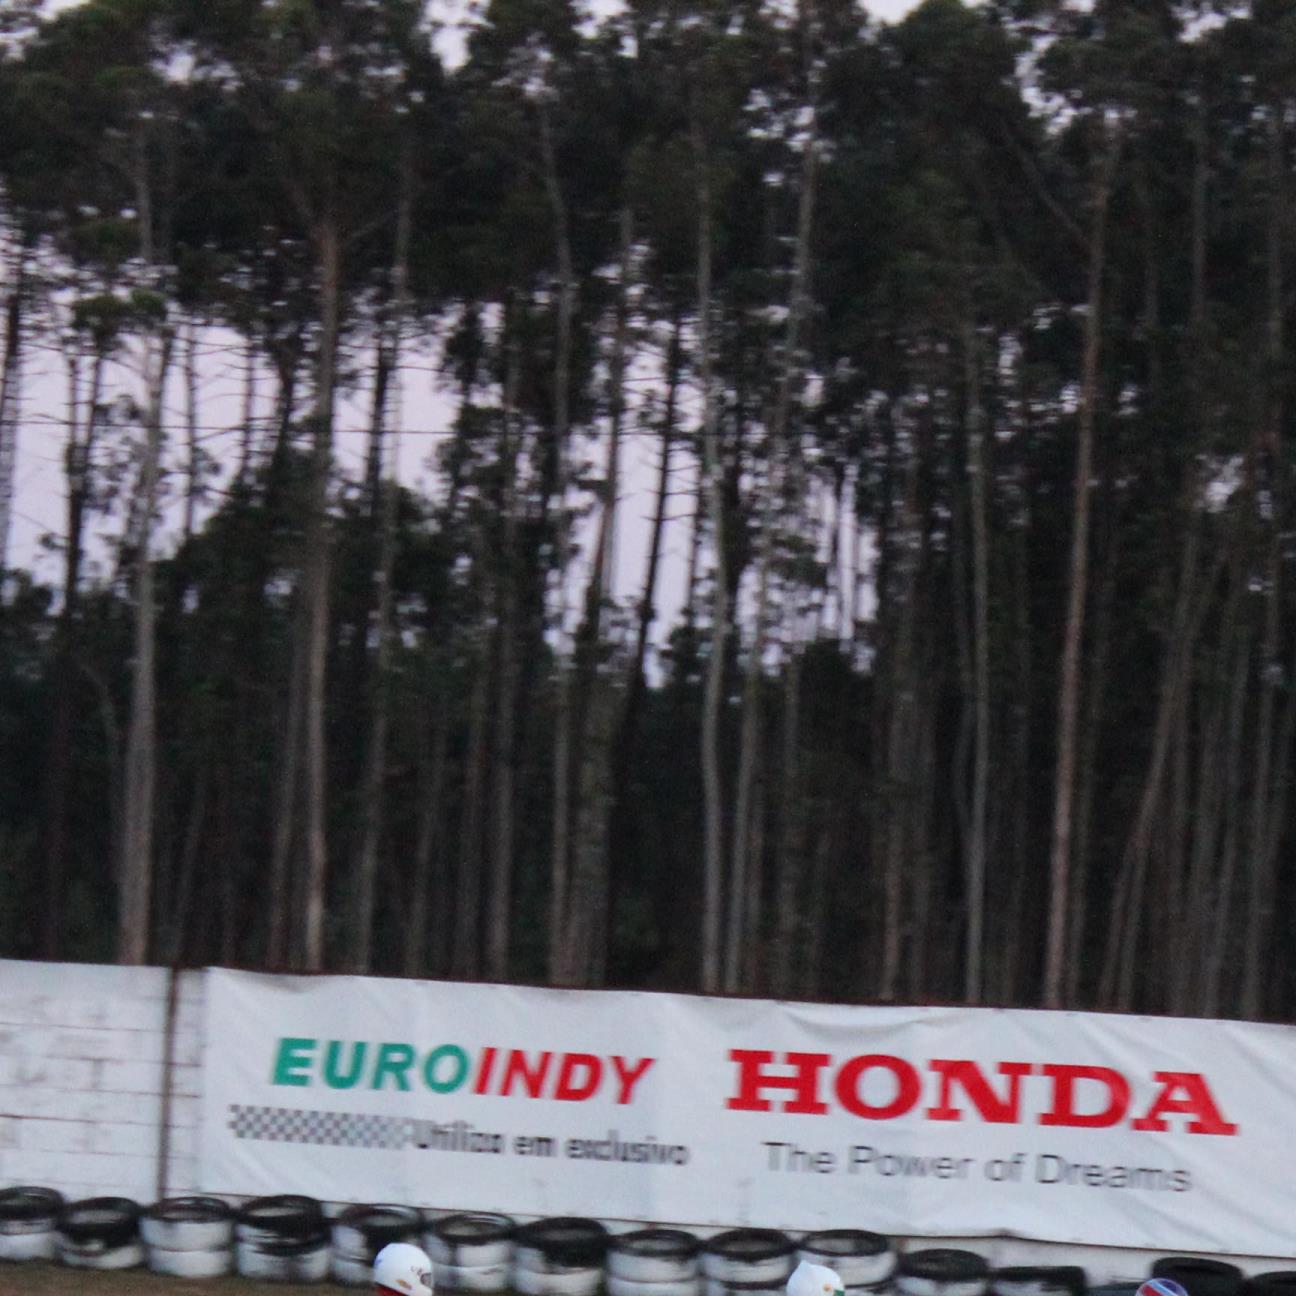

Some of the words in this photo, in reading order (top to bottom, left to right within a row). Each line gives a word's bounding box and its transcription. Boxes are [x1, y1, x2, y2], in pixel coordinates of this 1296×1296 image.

[271, 1036, 656, 1105] EUROINDY
[726, 1048, 1239, 1136] HONDA
[512, 1134, 556, 1158] em
[564, 1129, 689, 1166] exclusivo
[761, 1141, 835, 1175] The
[847, 1145, 973, 1180] Power
[984, 1152, 1027, 1182] of
[1036, 1153, 1191, 1193] Dreams
